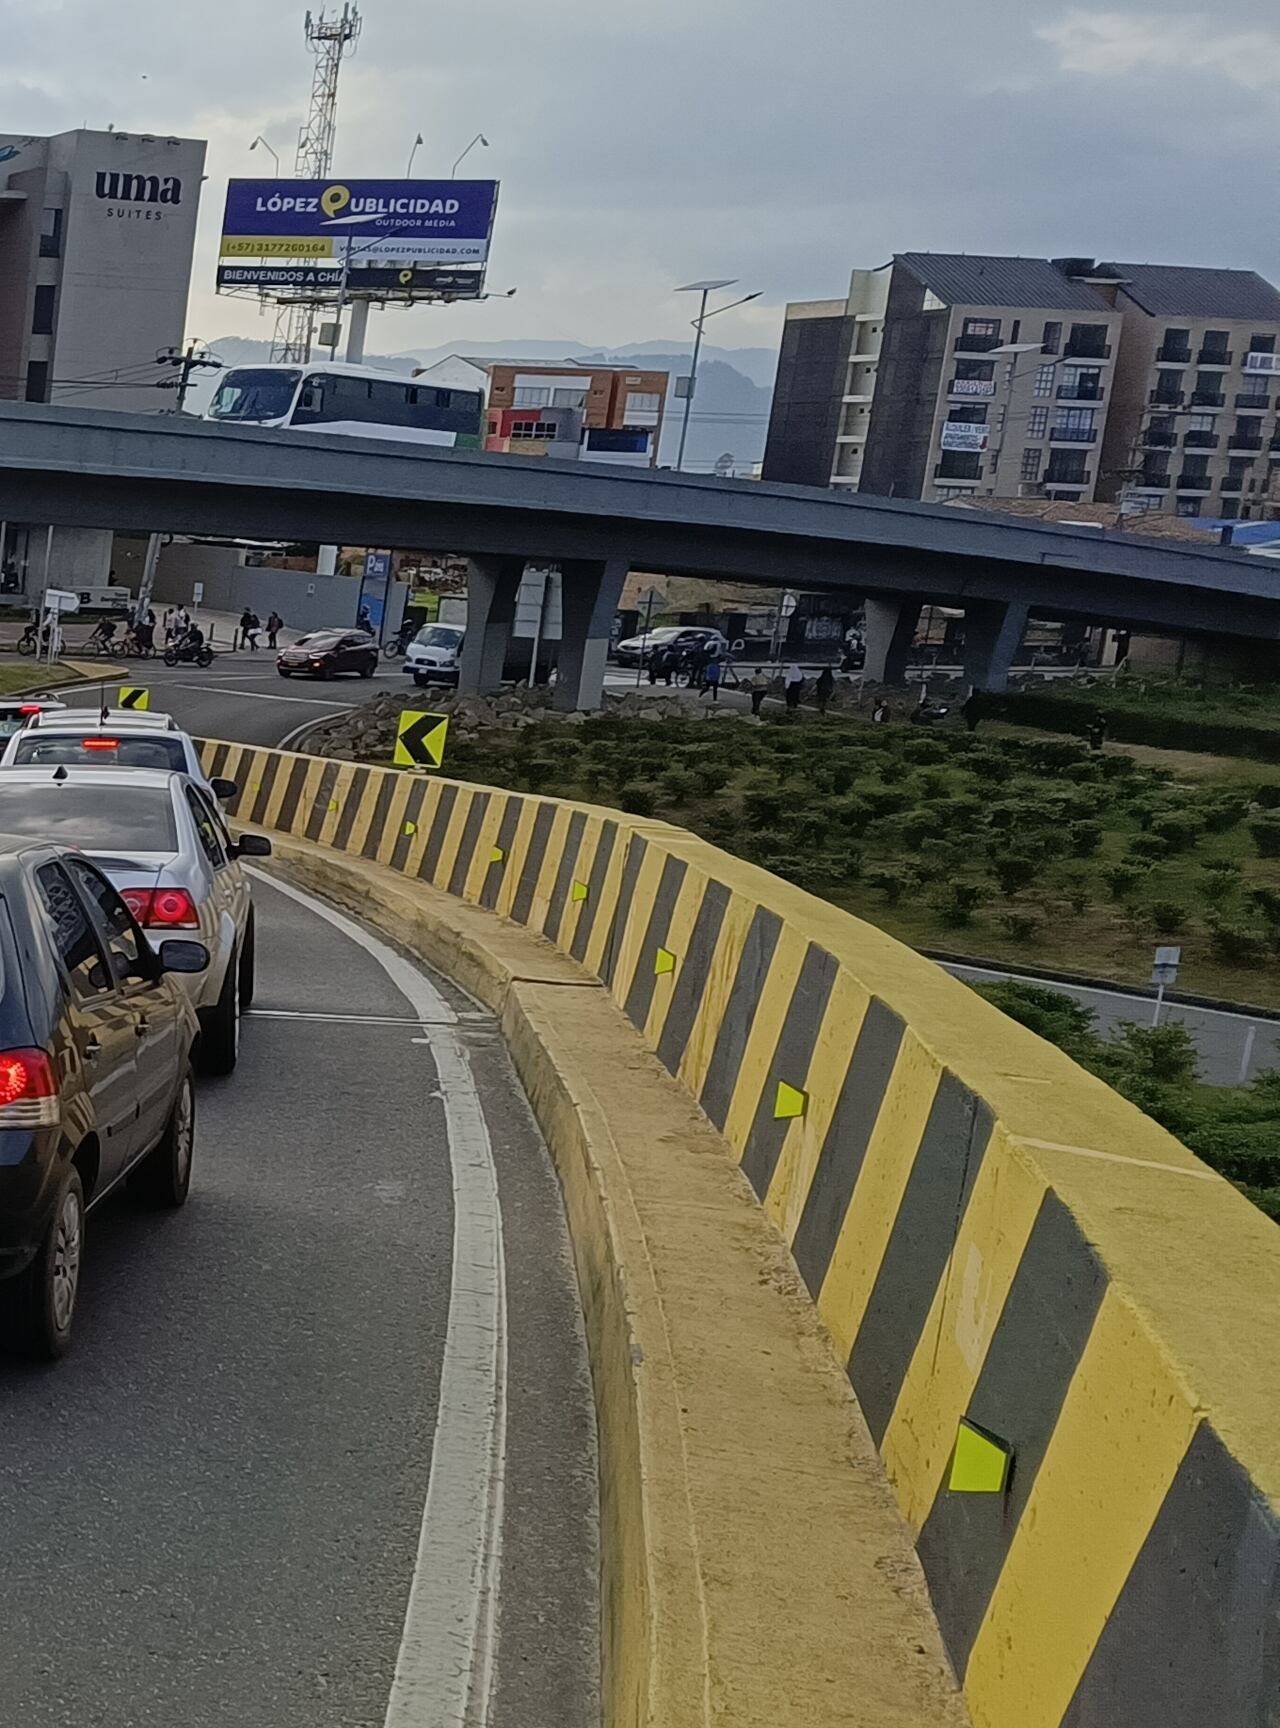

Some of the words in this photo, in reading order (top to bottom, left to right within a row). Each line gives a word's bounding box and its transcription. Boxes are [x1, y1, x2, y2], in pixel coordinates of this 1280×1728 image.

[95, 171, 182, 205] uma
[255, 193, 319, 212] LÓPEZ
[107, 208, 163, 220] SUITES
[375, 218, 422, 227] OUTDOOR
[424, 219, 456, 227] MEDIA
[226, 242, 255, 252] (+57)
[223, 269, 304, 281] BIENVENIDOS
[306, 271, 315, 281] A
